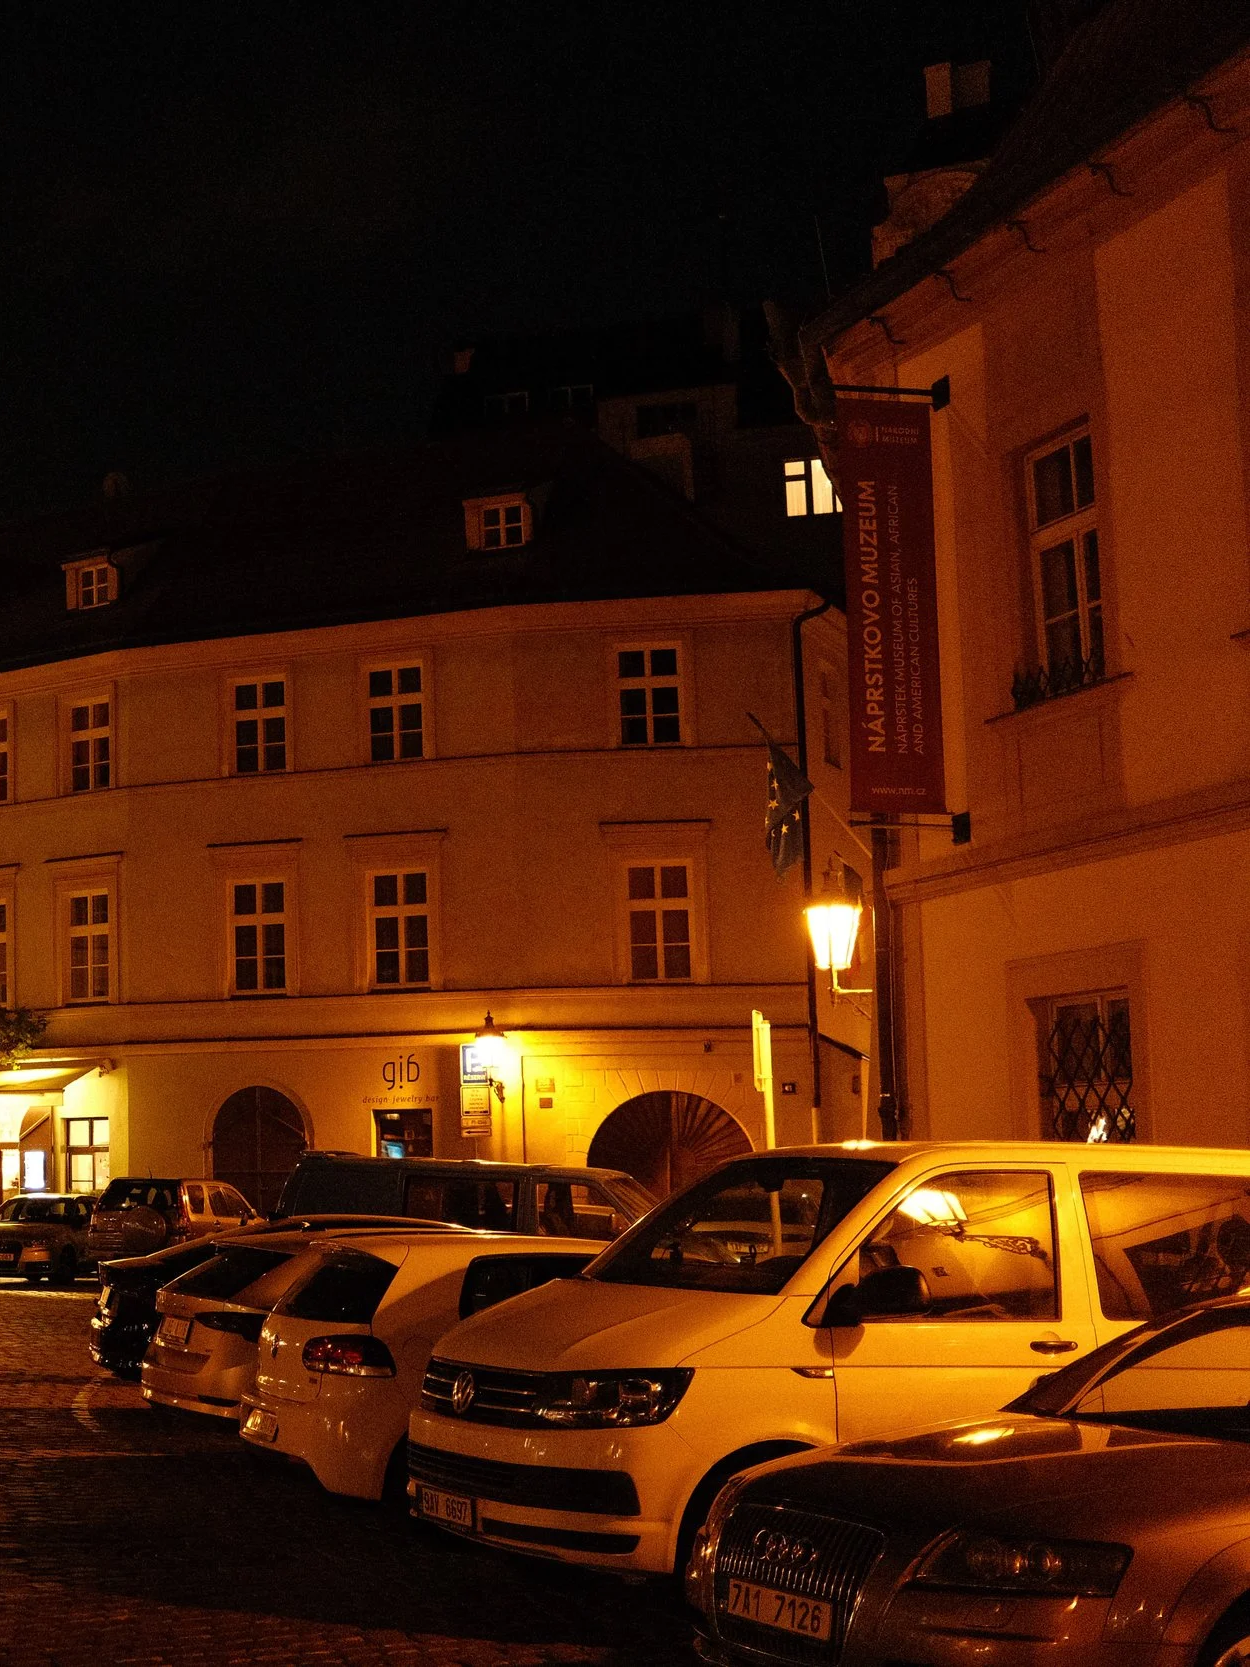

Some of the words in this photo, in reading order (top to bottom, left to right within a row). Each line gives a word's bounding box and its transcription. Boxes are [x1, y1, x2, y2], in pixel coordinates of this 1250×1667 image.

[857, 481, 879, 584] MUZEUM
[887, 485, 901, 545] AFRICAN
[889, 551, 902, 594] ASIAN,
[891, 598, 903, 617] OF
[907, 577, 920, 642] CULTURES
[861, 589, 886, 753] NÁPRSTKOVO
[892, 620, 906, 681] MUSEUM
[909, 646, 923, 720] AMERICAN
[912, 723, 925, 754] AND
[362, 1096, 388, 1104] design
[392, 1095, 423, 1104] jewelry
[425, 1094, 440, 1102] bar
[445, 1497, 468, 1521] 6697
[732, 1583, 762, 1618] 7A1
[774, 1594, 822, 1634] 7126
